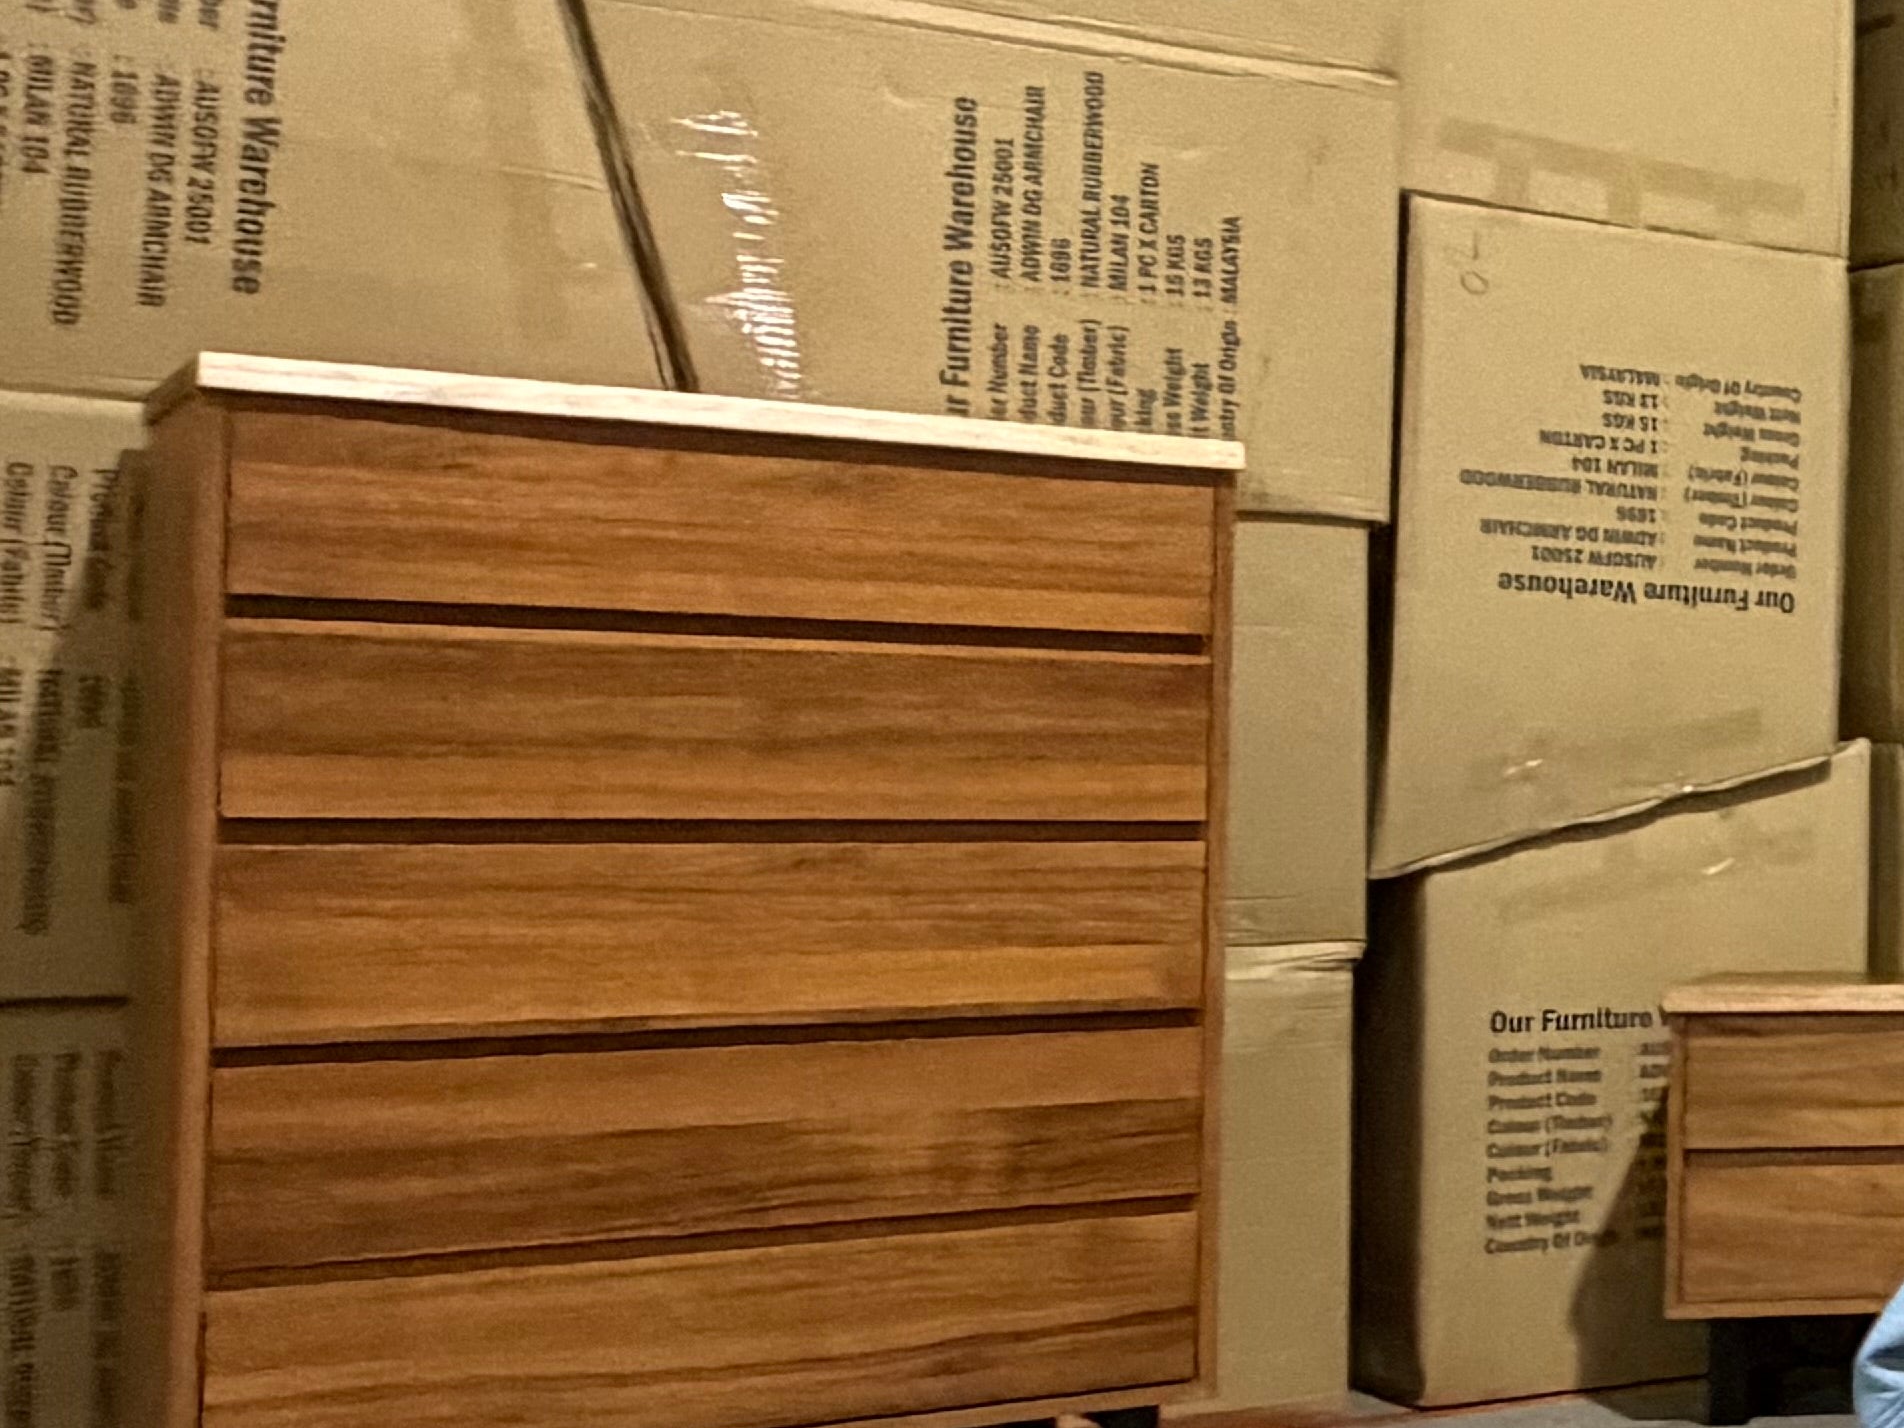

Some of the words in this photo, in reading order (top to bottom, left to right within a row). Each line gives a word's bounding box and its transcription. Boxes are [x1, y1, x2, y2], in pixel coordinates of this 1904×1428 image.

[943, 97, 977, 251] Warehouse
[991, 138, 1014, 197] 25001
[232, 117, 280, 294] Warehouse
[1021, 189, 1043, 216] DG
[1109, 194, 1130, 229] 104
[1138, 162, 1160, 235] CARTON
[989, 200, 1013, 280] AUSOFW
[1020, 219, 1042, 282] ADWIN
[1079, 208, 1102, 288] NATURAL
[1138, 238, 1157, 250] X
[1166, 234, 1186, 271] KGS
[1193, 237, 1214, 274] KGS
[1049, 238, 1072, 282] 1696
[1107, 232, 1130, 291] MILAN
[1136, 254, 1157, 278] PC
[1220, 216, 1241, 304] MALAYSIA
[1137, 283, 1156, 293] 1
[1164, 274, 1185, 295] 15
[1192, 277, 1213, 298] 13
[938, 260, 973, 387] Furniture
[1498, 572, 1636, 604] Warehouse
[1644, 582, 1748, 611] Furniture
[1754, 590, 1795, 614] Our
[1489, 1010, 1534, 1034] Our
[1541, 1007, 1653, 1032] Furniture
